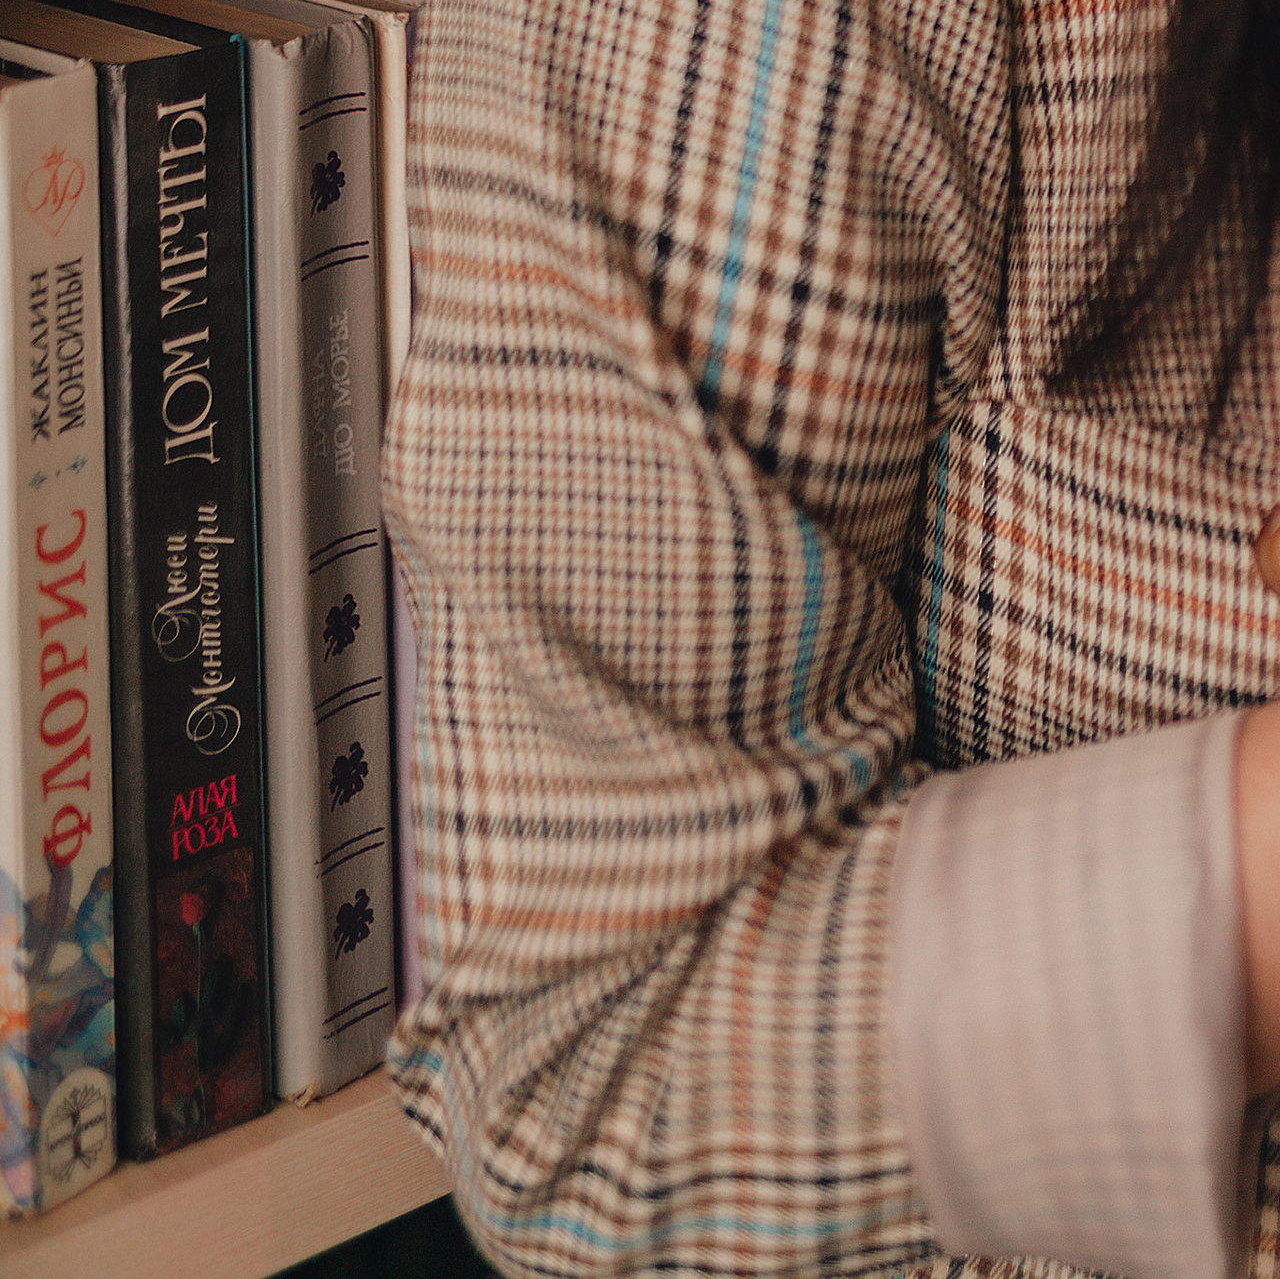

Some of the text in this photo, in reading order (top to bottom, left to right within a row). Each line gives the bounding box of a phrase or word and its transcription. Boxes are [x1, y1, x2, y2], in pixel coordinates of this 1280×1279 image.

[29, 267, 53, 443] ЖАКЛИН
[56, 255, 85, 438] МОНСИНЬИ
[157, 92, 222, 467] ДОМ МЕЧТЫ
[329, 307, 352, 410] МОРЬЕ
[151, 529, 204, 663] Люси
[186, 500, 242, 756] Монтгомери
[35, 508, 93, 868] ФЛОРИС
[170, 773, 240, 829] АЛАЯ
[171, 809, 240, 862] РОЗА
